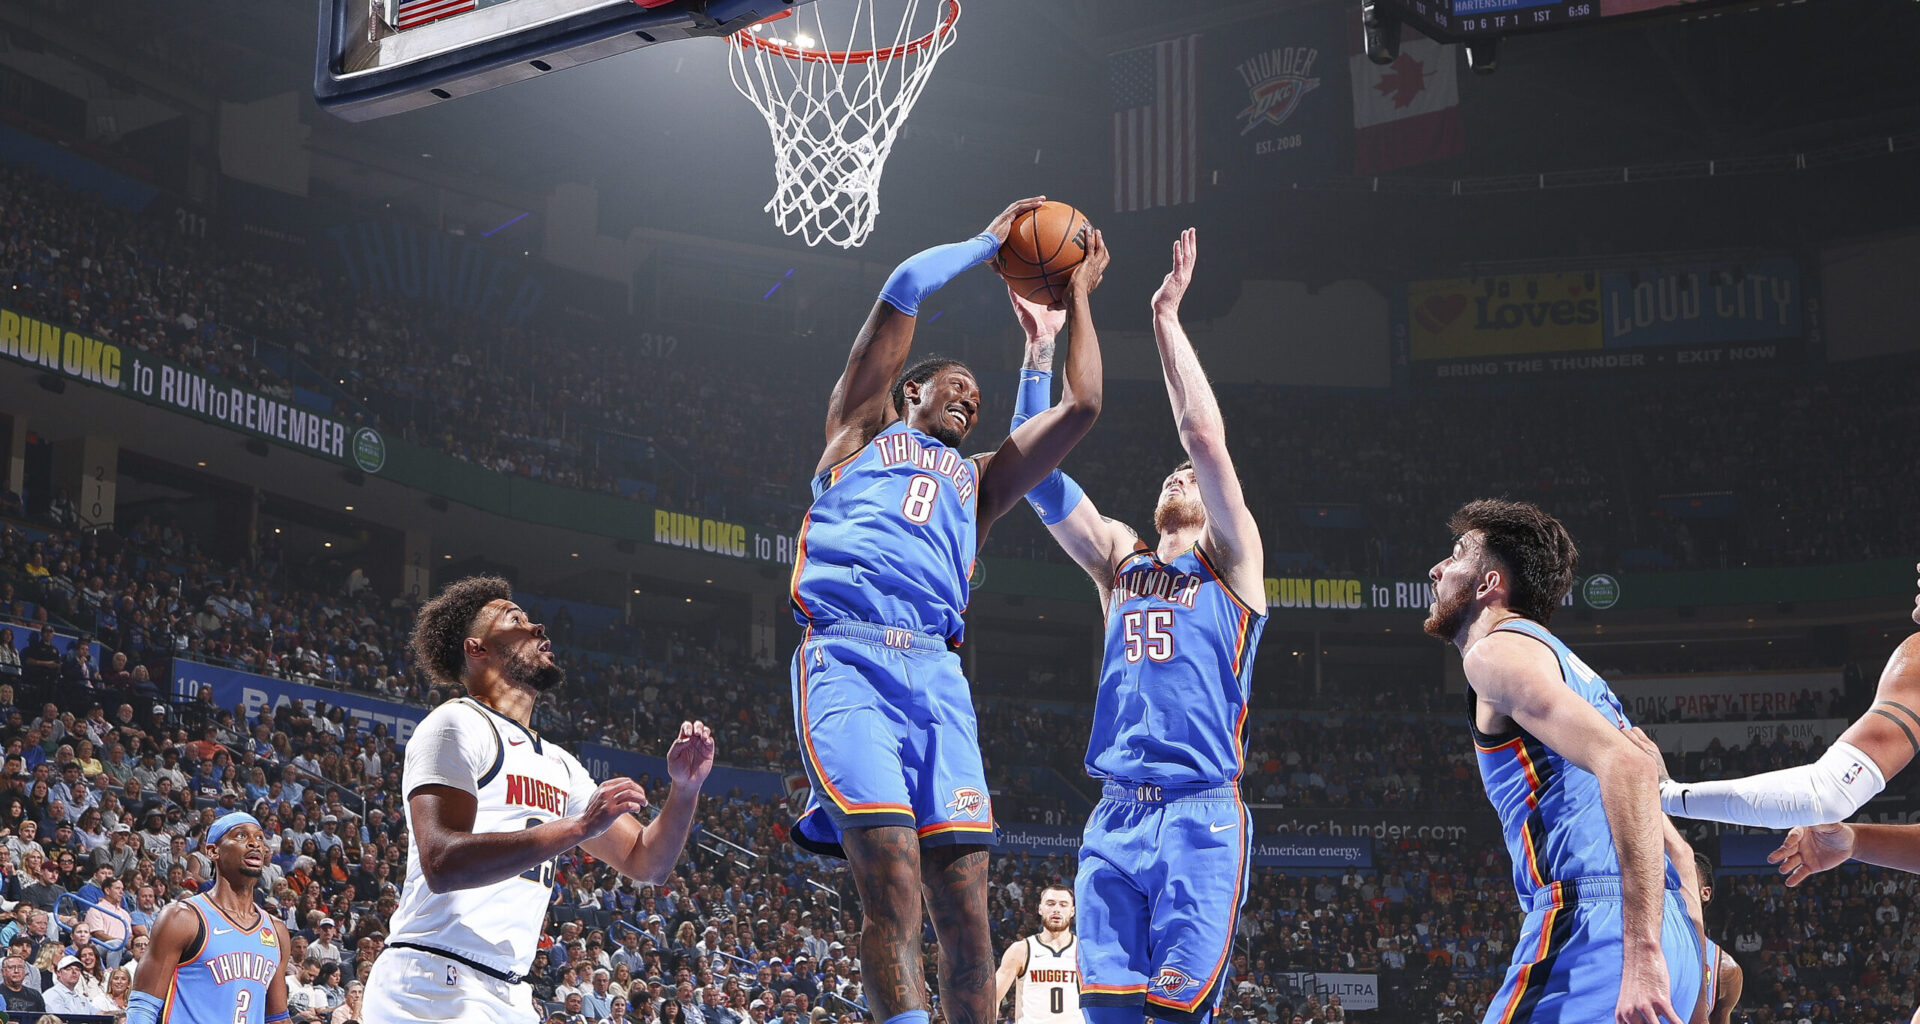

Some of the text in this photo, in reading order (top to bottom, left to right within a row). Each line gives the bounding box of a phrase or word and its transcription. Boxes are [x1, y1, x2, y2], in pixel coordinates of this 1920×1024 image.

[1463, 20, 1475, 31] TO
[1480, 18, 1487, 29] 6
[1494, 16, 1506, 28] TF
[1533, 10, 1551, 22] 1ST
[1568, 4, 1590, 17] 6:56
[1235, 47, 1318, 88] THUNDER
[1256, 134, 1302, 154] EST. 2008
[1611, 270, 1792, 337] LOUD CITY
[1, 309, 61, 370] RUN
[63, 331, 122, 388] OKC
[133, 358, 154, 396] to
[1437, 345, 1777, 377] BRING THE THUNDER EXIT NOW
[873, 431, 974, 507] THUNDER
[92, 465, 105, 518] 210
[902, 473, 939, 526] 8
[654, 508, 700, 550] RUN
[702, 518, 746, 558] OKC
[755, 532, 771, 560] to
[1265, 577, 1312, 608] RUN
[1314, 578, 1362, 609] OKC
[1371, 583, 1390, 608] to
[885, 628, 913, 649] OKC
[1123, 608, 1175, 664] 55
[178, 676, 212, 704] 10
[1635, 695, 1669, 716] OAK
[1675, 694, 1733, 714] PARTY
[1747, 723, 1816, 739] POST OAK
[957, 794, 979, 811] OKC
[1136, 785, 1163, 802] OKC
[1006, 830, 1081, 849] independent
[1258, 843, 1316, 857] American
[1319, 846, 1361, 860] energy.
[205, 951, 277, 990] THUNDE
[1155, 975, 1182, 988] OKC
[1050, 987, 1064, 1014] 0
[1328, 983, 1374, 996] ULTRA
[232, 988, 252, 1024] 2
